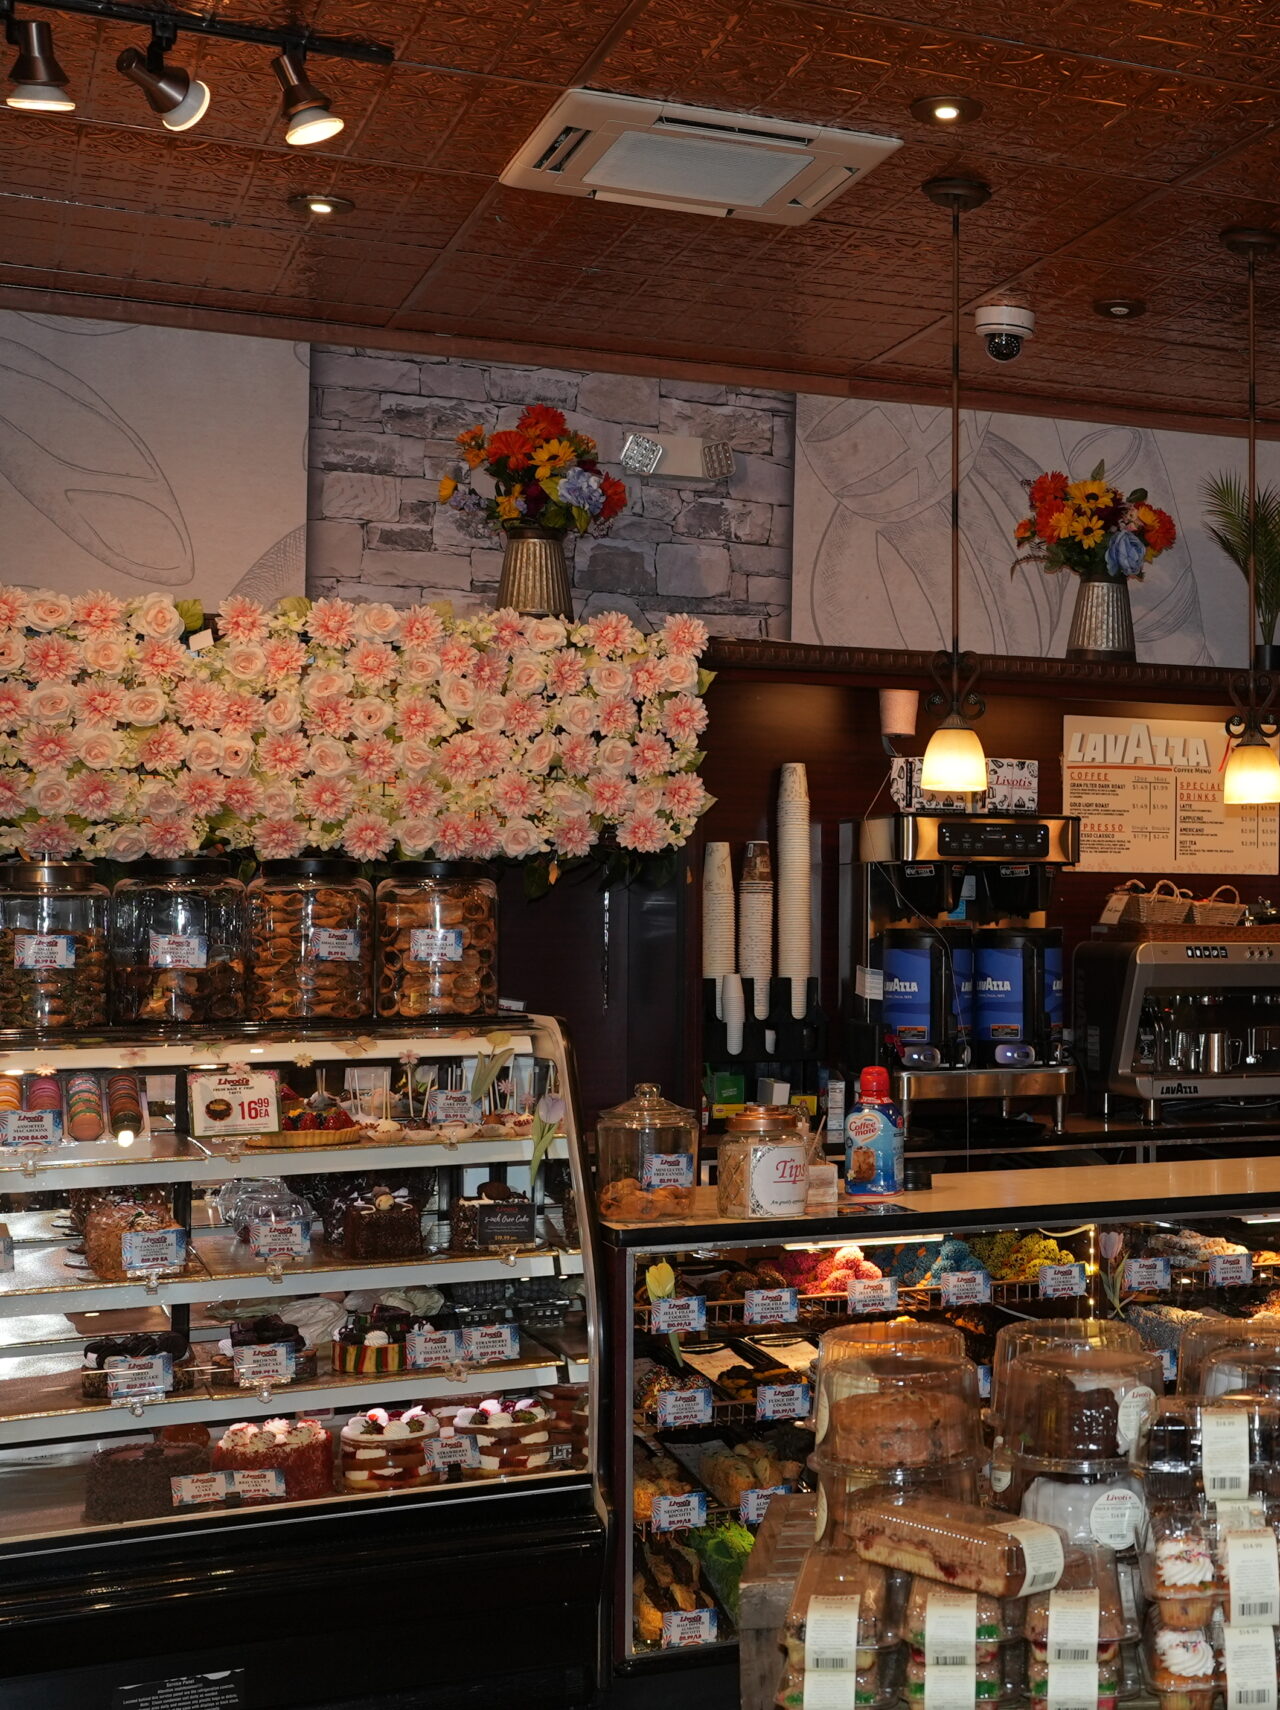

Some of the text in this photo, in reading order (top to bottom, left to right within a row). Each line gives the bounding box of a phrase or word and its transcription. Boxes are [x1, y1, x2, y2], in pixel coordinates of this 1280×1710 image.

[1068, 723, 1210, 767] LAVAZZA
[1070, 772, 1109, 780] COFFEE
[1180, 792, 1217, 800] DRINKS
[1160, 1082, 1198, 1095] LAVAZZA
[238, 1098, 270, 1120] 16 99
[260, 1109, 269, 1117] EA
[849, 1121, 876, 1131] Coffee
[855, 1128, 876, 1136] mate
